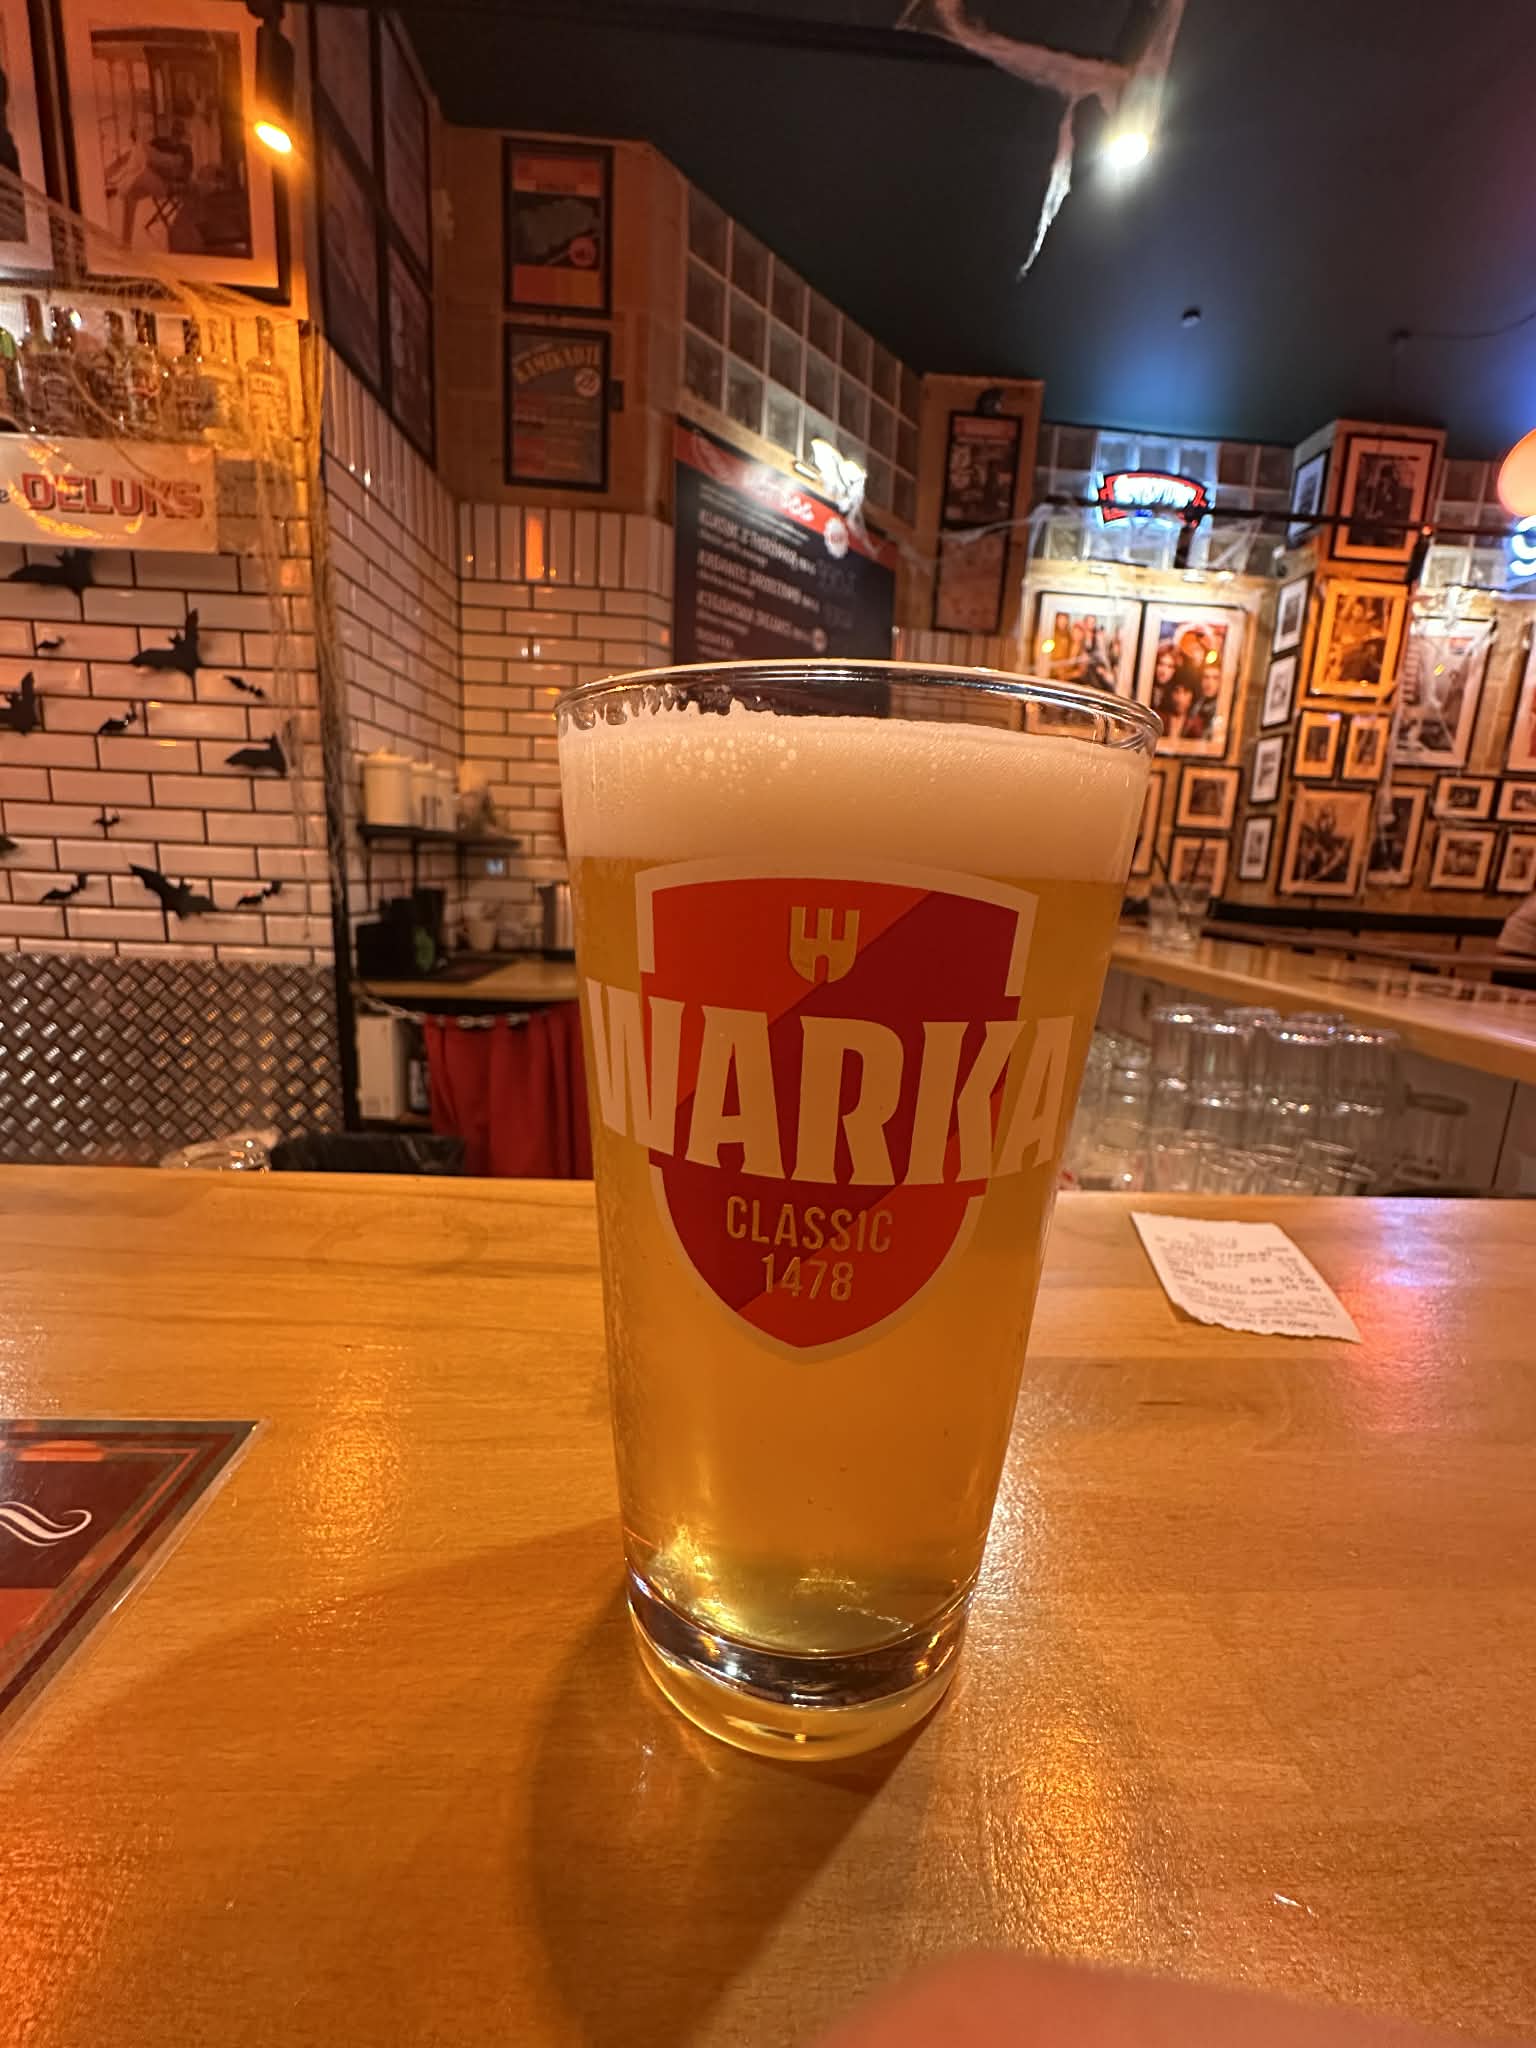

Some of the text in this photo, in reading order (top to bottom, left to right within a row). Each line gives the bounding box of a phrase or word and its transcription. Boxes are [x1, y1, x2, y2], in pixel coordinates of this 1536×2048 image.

[585, 976, 1074, 1186] WARKA
[725, 1195, 894, 1253] CLASSIC
[760, 1255, 855, 1301] 1478
